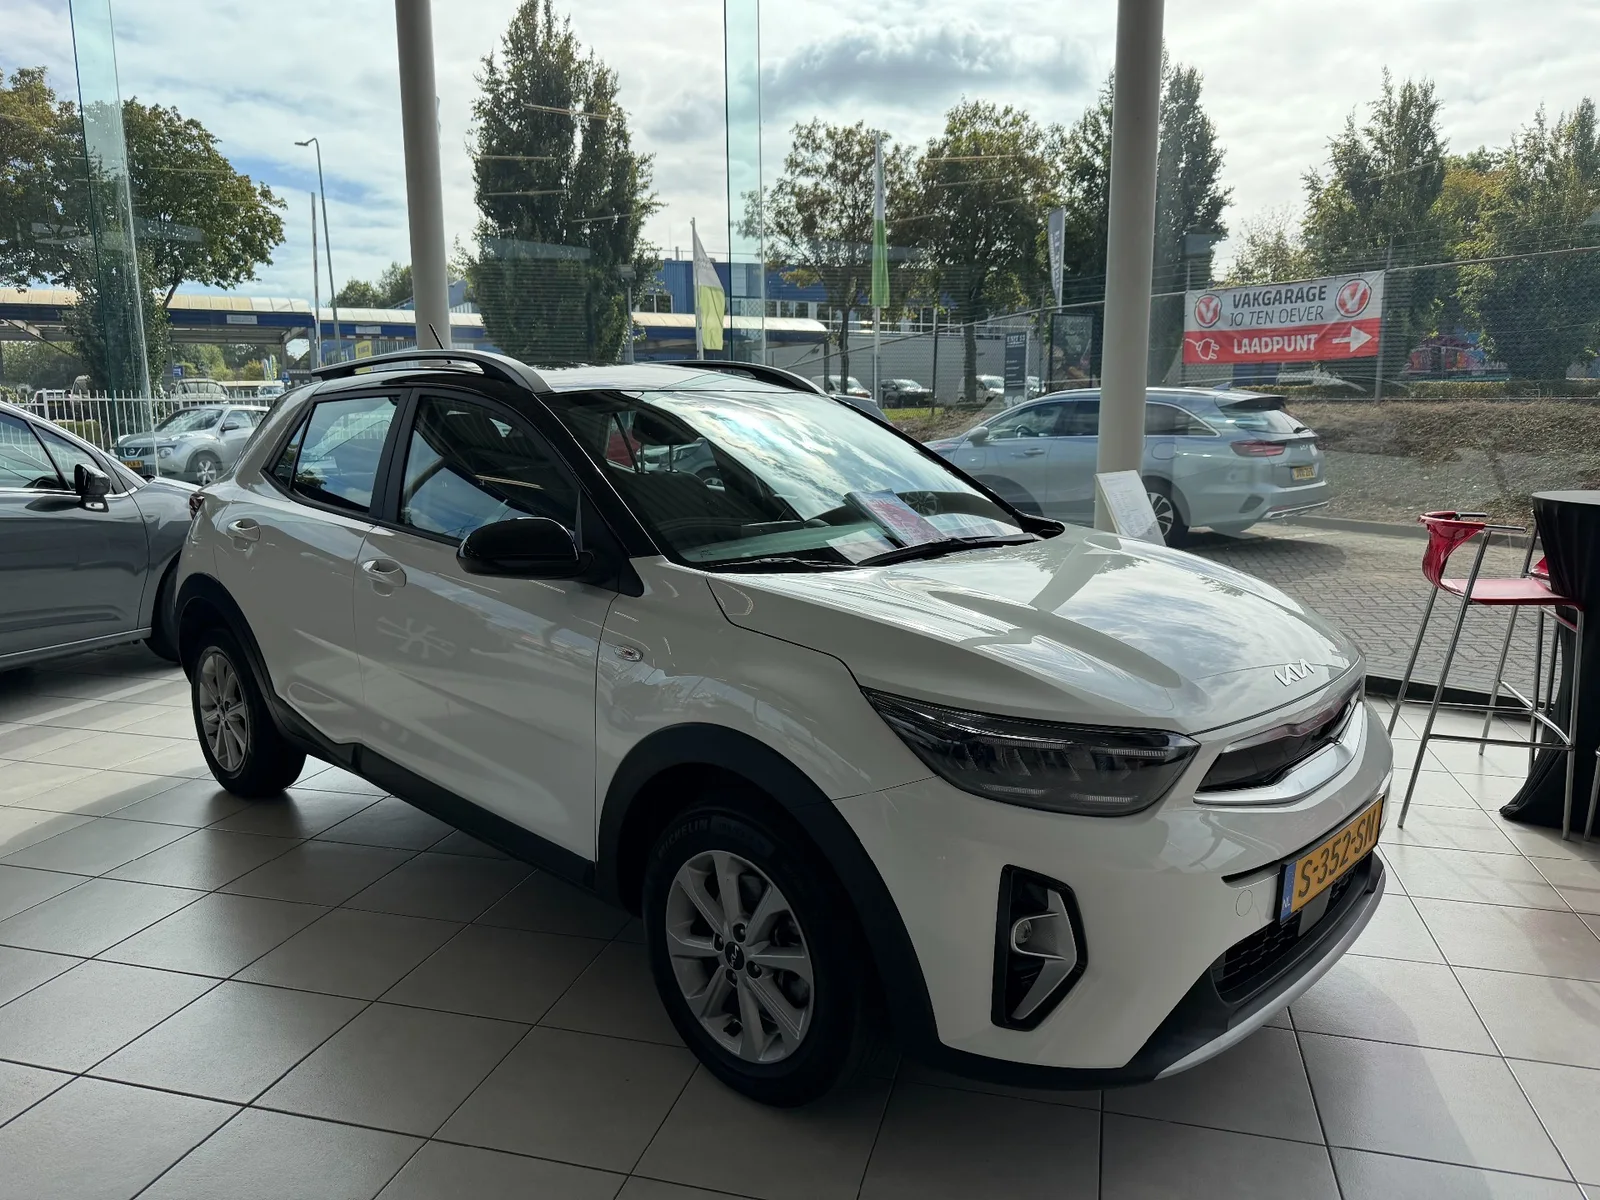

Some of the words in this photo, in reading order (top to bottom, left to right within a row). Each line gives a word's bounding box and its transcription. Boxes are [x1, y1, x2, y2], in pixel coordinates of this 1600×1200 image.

[1232, 285, 1327, 309] VAKGARAGE
[1229, 312, 1244, 327] JO
[1249, 309, 1274, 326] TEN
[1278, 305, 1324, 324] OEVER
[1233, 333, 1319, 355] LAADPUNT
[1273, 658, 1315, 687] KIA
[1298, 808, 1377, 898] S-352-SN
